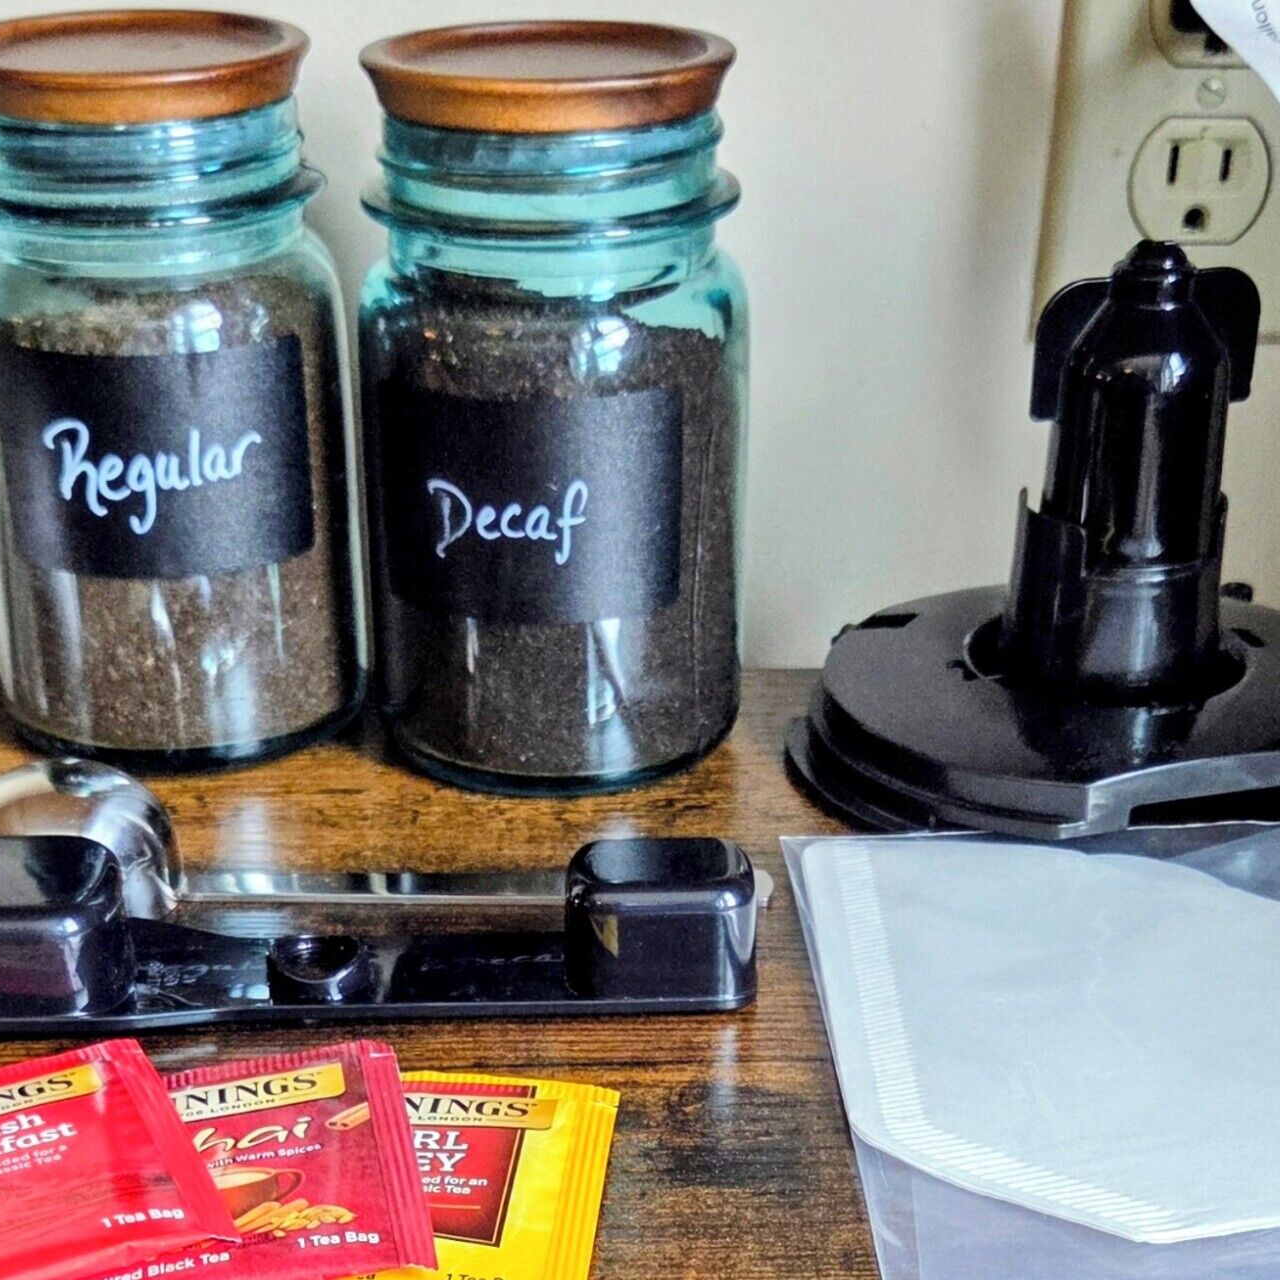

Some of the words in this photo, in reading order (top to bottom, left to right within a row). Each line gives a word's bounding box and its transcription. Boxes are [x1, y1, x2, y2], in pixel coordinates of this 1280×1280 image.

[42, 418, 262, 535] Regular
[428, 479, 587, 565] Decaf
[183, 1073, 318, 1110] NINGS
[210, 1098, 275, 1113] LONDON
[404, 1097, 529, 1117] NINGS
[193, 1117, 312, 1152] hai
[414, 1130, 469, 1150] RL
[33, 1146, 57, 1159] for
[35, 1154, 62, 1166] Tea
[235, 1150, 275, 1163] Warm
[277, 1143, 322, 1158] Spices
[417, 1152, 466, 1172] EY
[444, 1176, 466, 1185] for
[469, 1178, 487, 1186] an
[445, 1186, 471, 1194] Tea
[102, 1217, 111, 1229] 1
[114, 1212, 145, 1225] Tea
[148, 1206, 185, 1221] Bag
[296, 1238, 305, 1248] 1
[312, 1234, 340, 1246] Tea
[345, 1231, 379, 1244] Bag
[147, 1257, 195, 1277] Black
[199, 1249, 230, 1266] Tea
